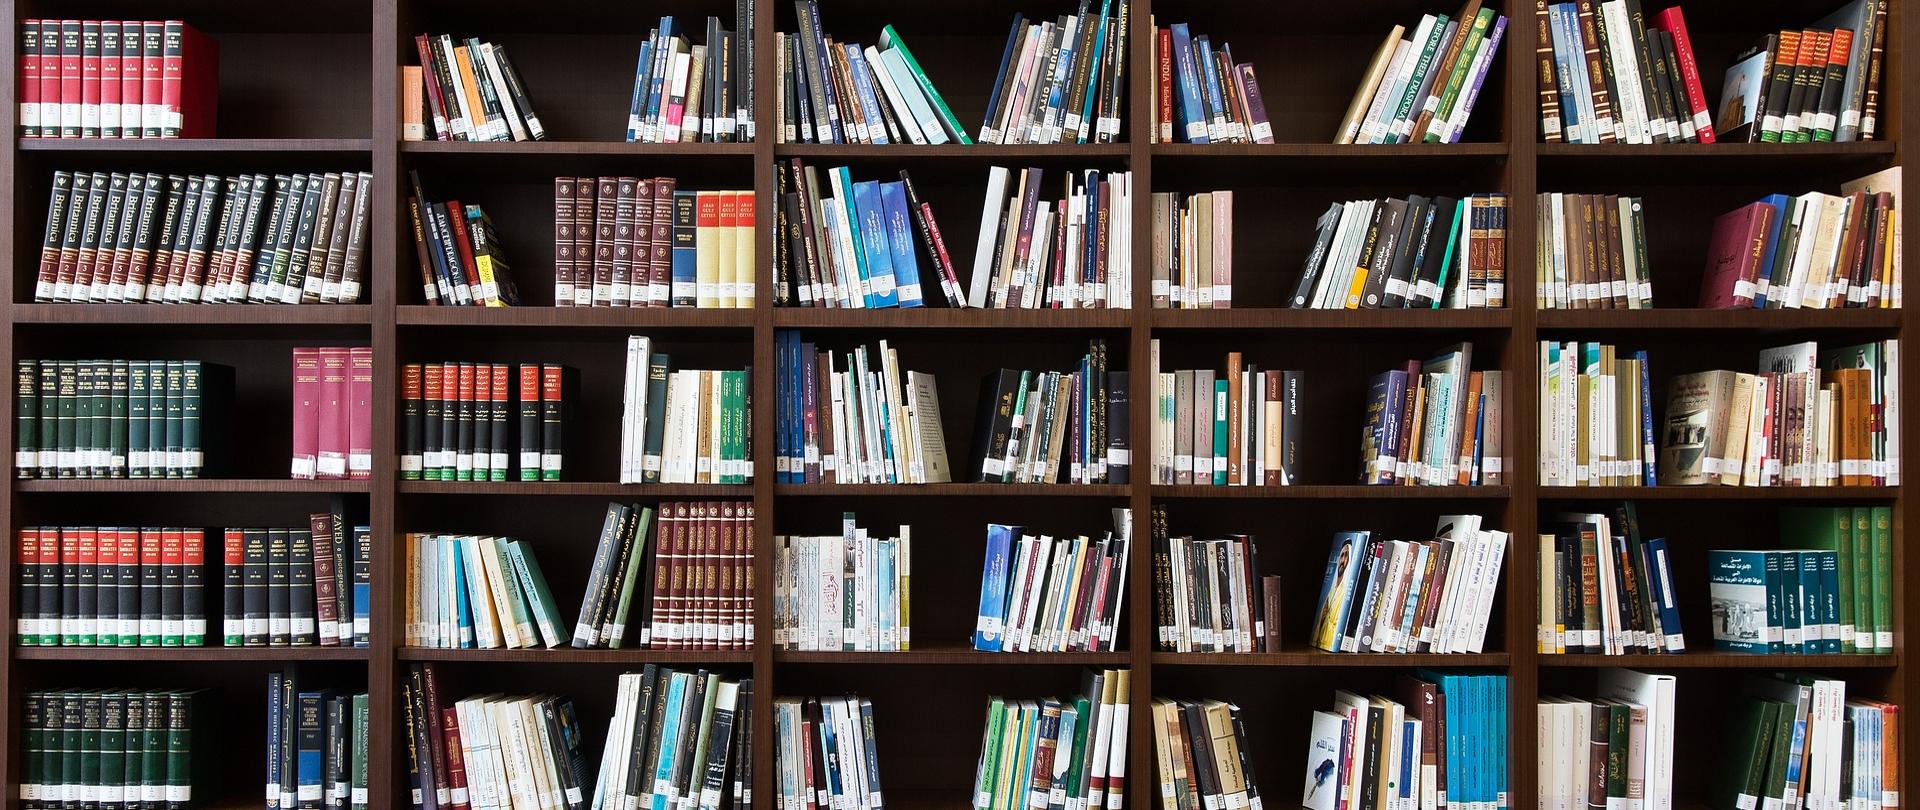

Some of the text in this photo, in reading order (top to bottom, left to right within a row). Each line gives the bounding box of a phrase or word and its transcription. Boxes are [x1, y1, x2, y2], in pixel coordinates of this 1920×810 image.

[798, 8, 813, 49] ARCHAEOLOGY
[807, 50, 814, 59] OF
[1119, 17, 1127, 36] DHABI
[1459, 14, 1474, 36] INDIA
[1631, 11, 1646, 41] زايد
[1037, 47, 1060, 112] DUBAI CITY
[1398, 22, 1444, 120] BEFORE THEIR DIASPORA
[50, 194, 65, 242] Britannica
[68, 195, 84, 243] Britannica
[87, 195, 102, 243] Britannica
[105, 196, 120, 243] Britannica
[122, 195, 138, 243] Britannica
[139, 195, 155, 243] Britannica
[162, 198, 178, 245] Britannica
[179, 199, 196, 246] Britannica
[196, 198, 213, 244] Britannica
[217, 199, 233, 246] Britannica
[229, 197, 246, 244] Britannica
[244, 197, 261, 243] Britannica
[266, 198, 283, 244] Britannica
[282, 196, 299, 243] Britannica
[333, 514, 342, 543] ZAYED
[336, 553, 344, 598] photographic
[284, 679, 292, 708] زايد
[640, 685, 652, 715] زايد
